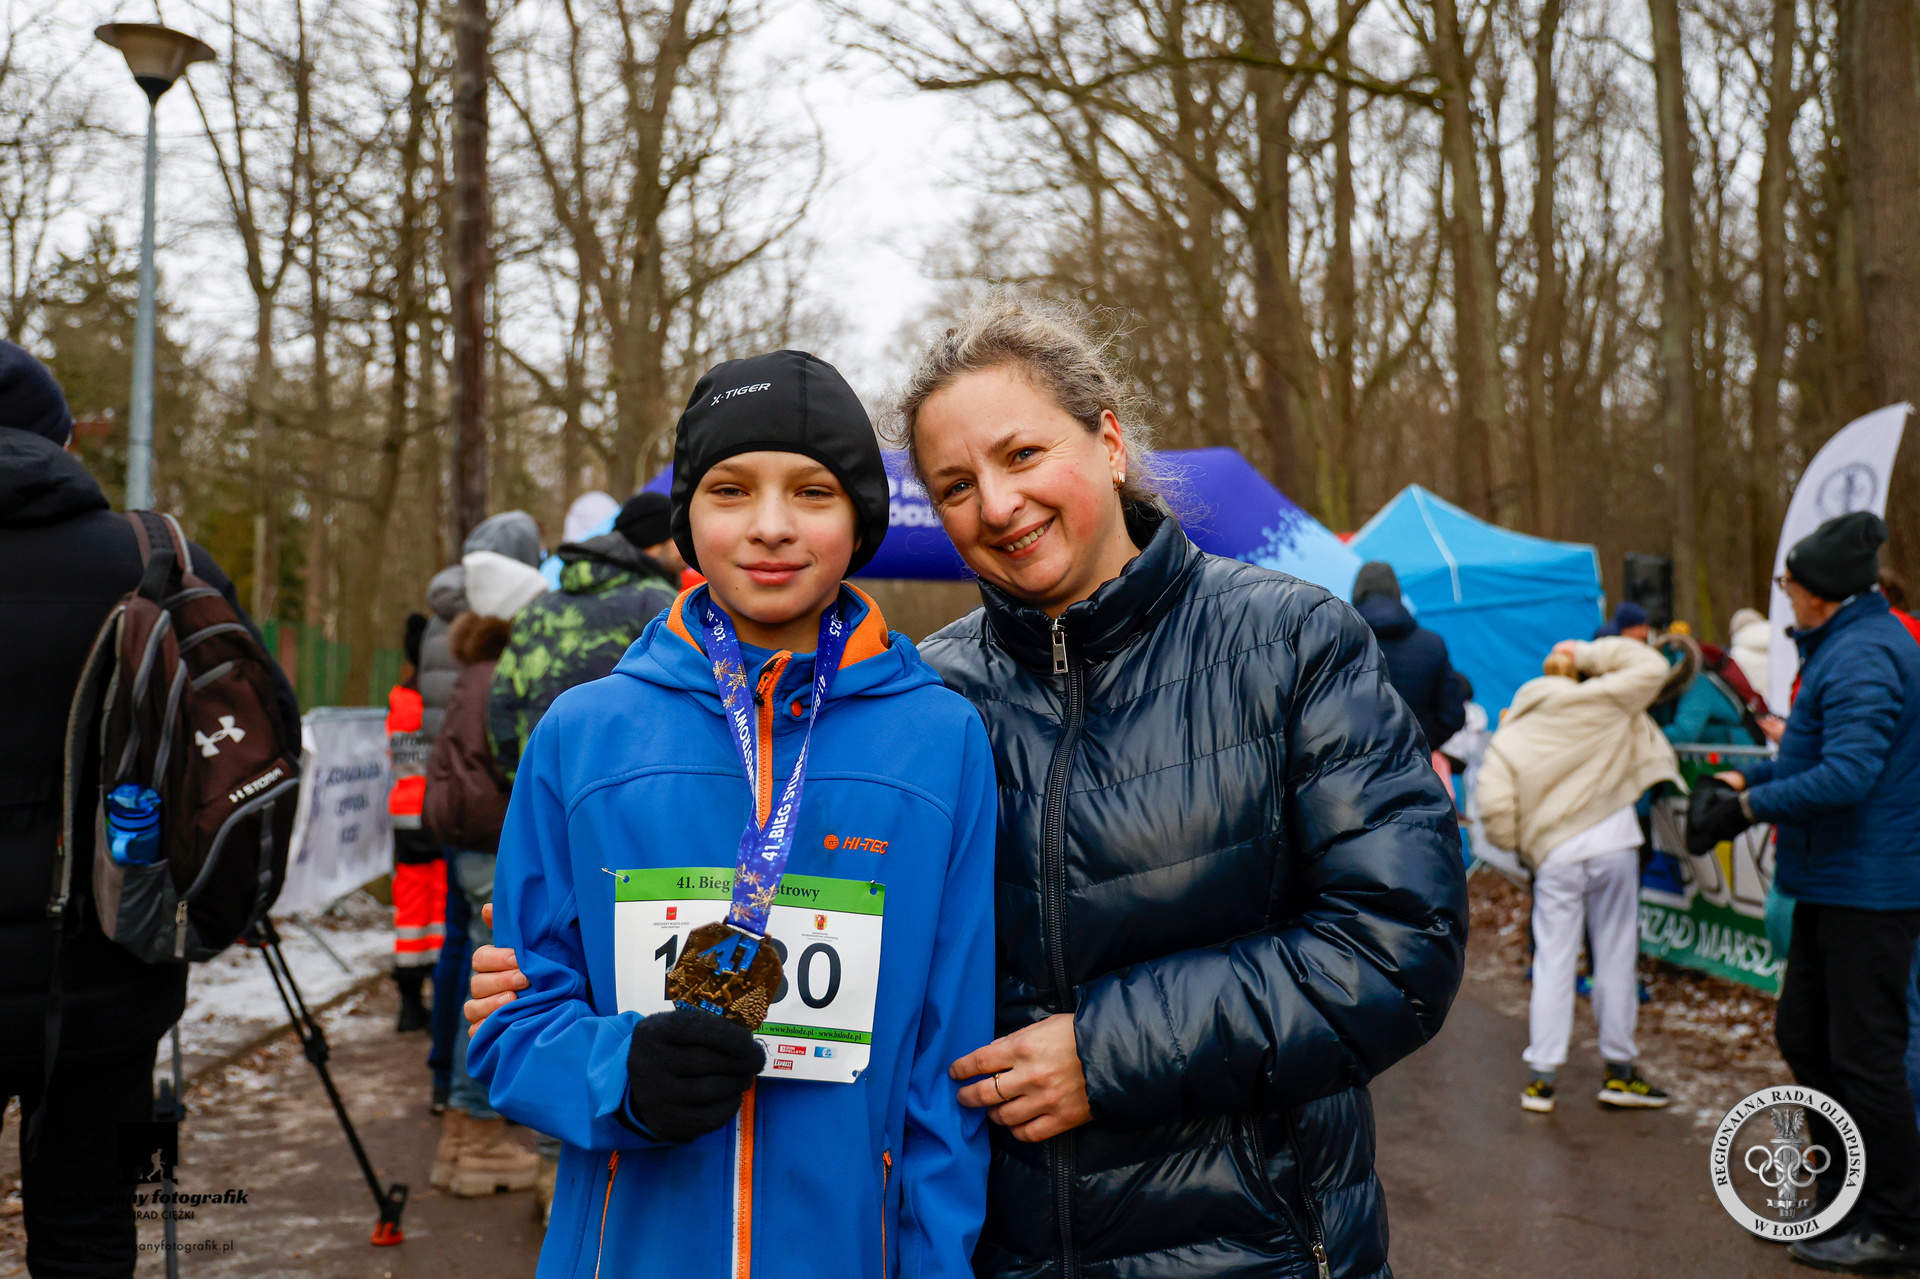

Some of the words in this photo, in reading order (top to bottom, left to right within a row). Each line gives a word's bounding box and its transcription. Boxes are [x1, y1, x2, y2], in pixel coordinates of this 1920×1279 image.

[711, 383, 771, 406] X-TIGER
[842, 836, 889, 855] HI-TEC
[676, 876, 695, 889] 41.
[699, 877, 731, 893] Bieg
